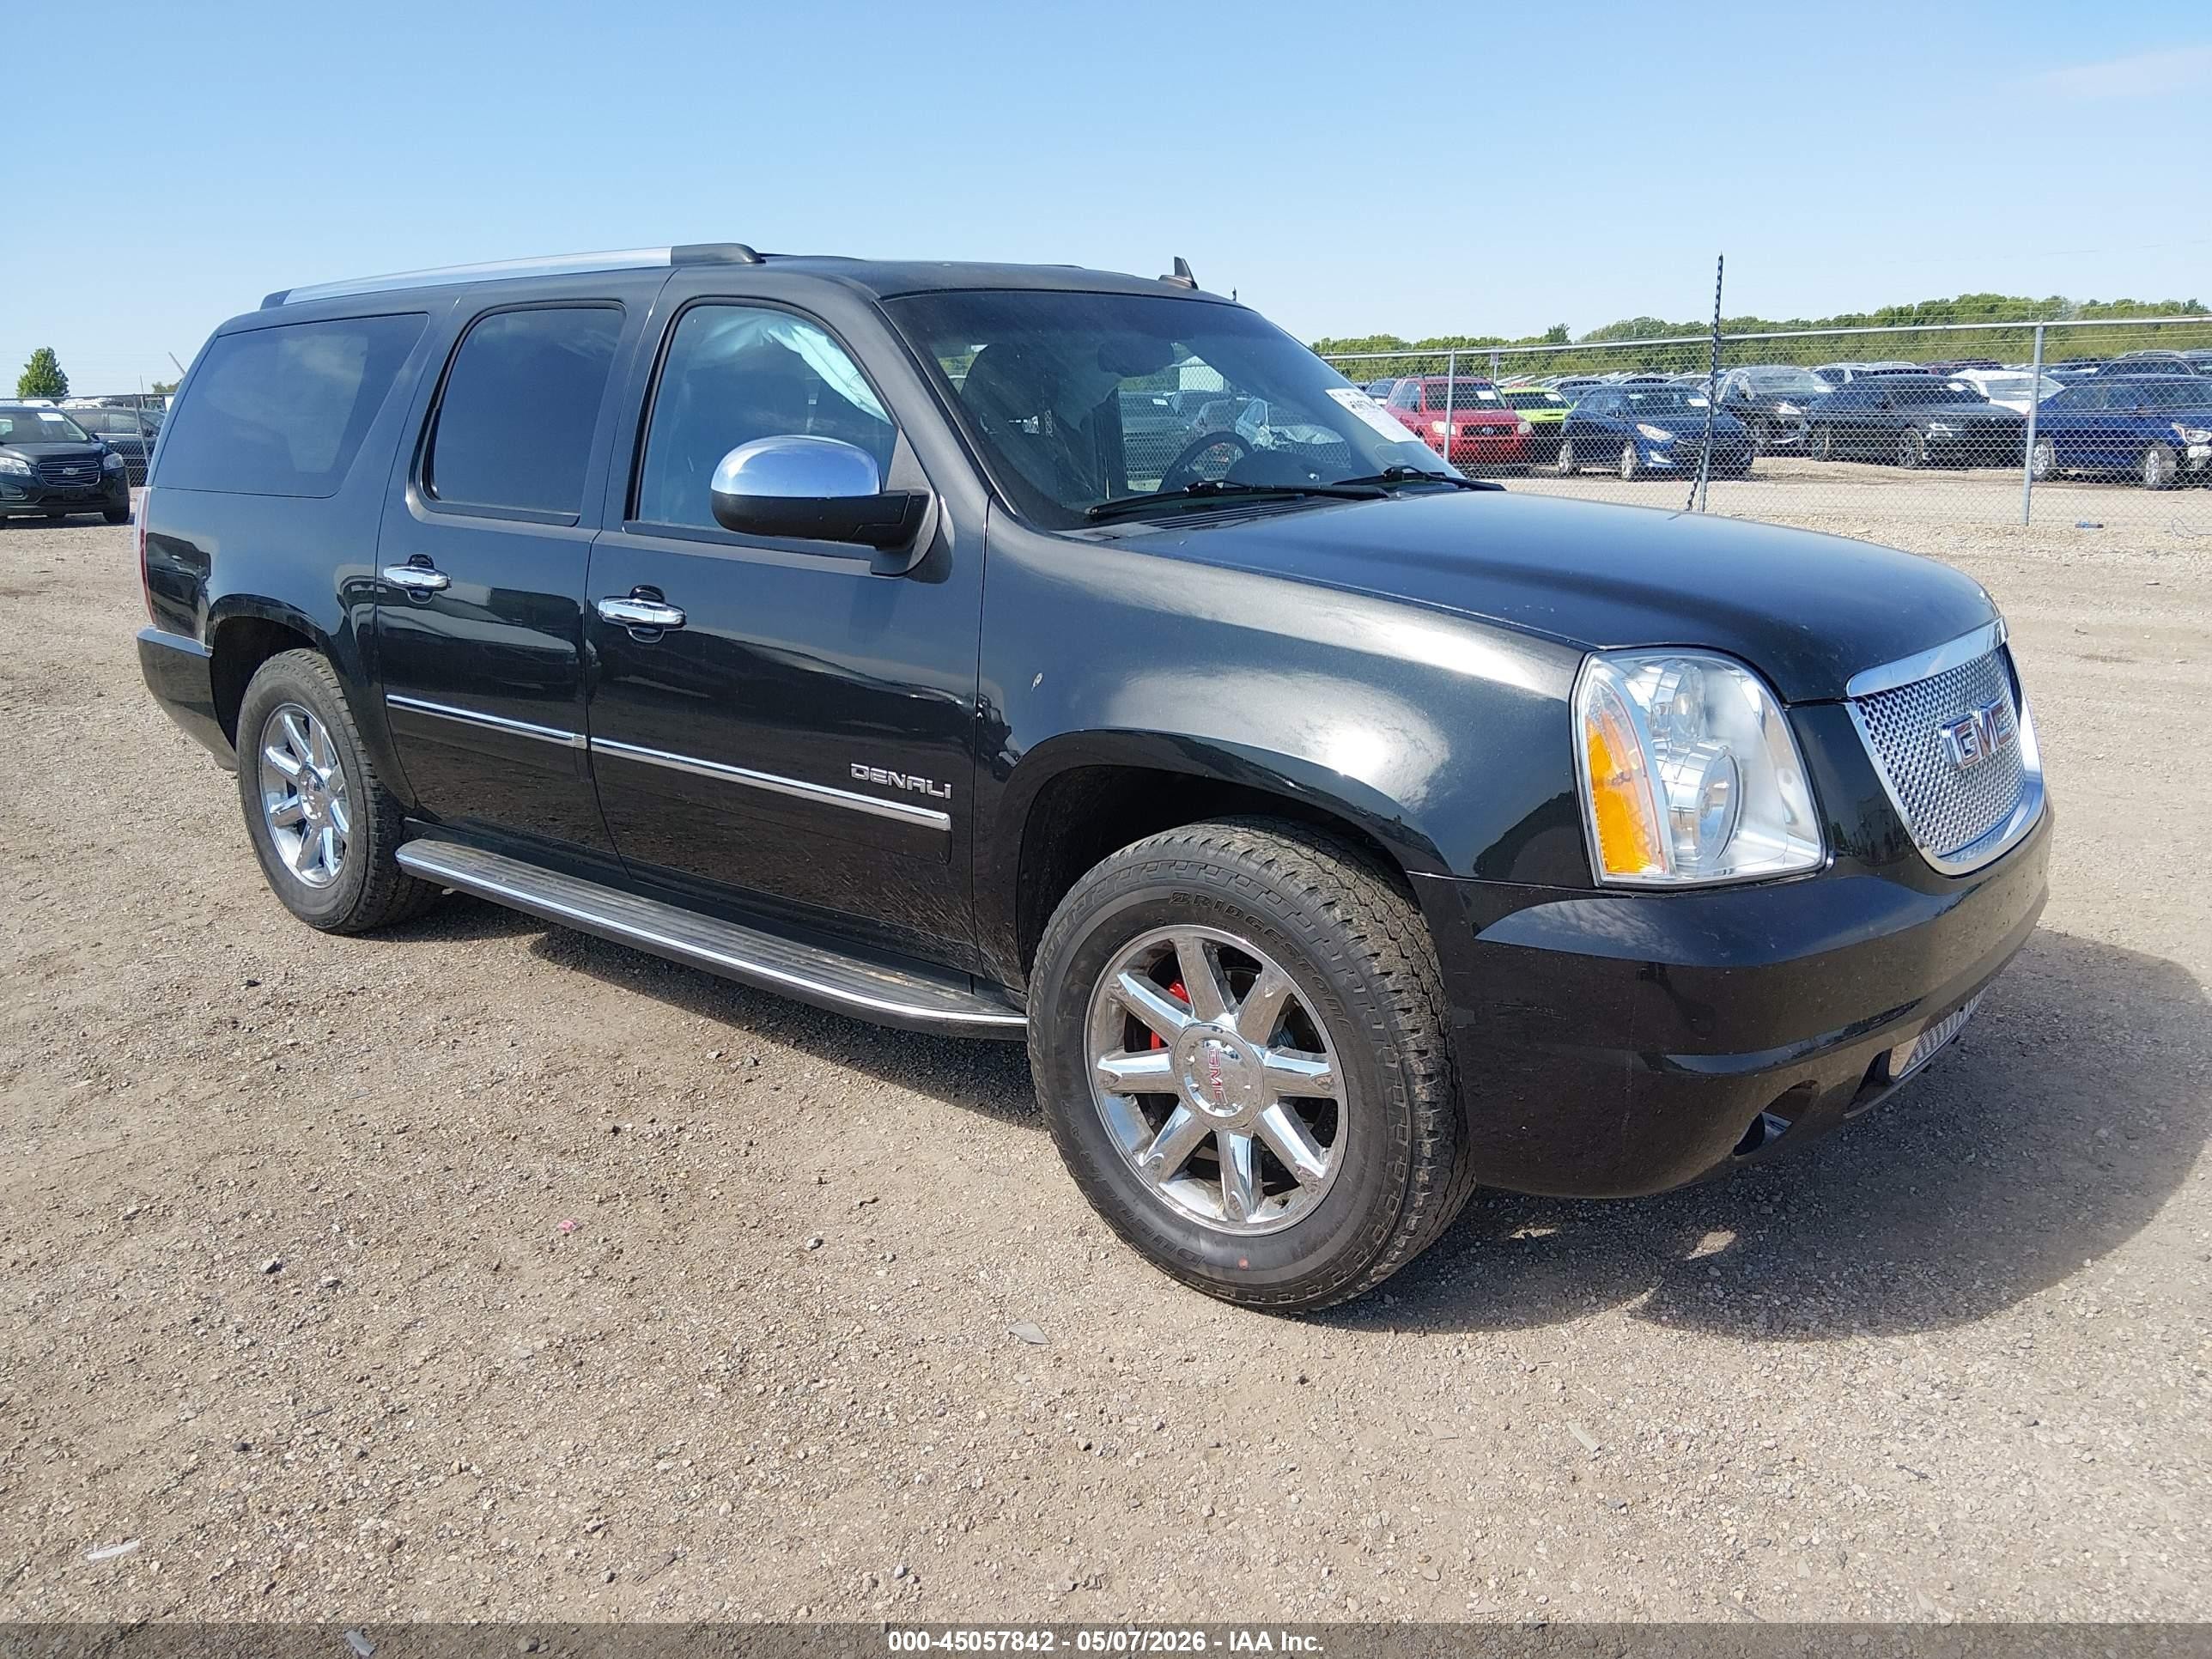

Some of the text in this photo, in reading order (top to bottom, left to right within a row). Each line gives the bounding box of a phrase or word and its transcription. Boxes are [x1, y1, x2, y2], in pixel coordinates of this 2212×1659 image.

[1942, 698, 2012, 769] GMC
[850, 763, 951, 799] DENALI
[1208, 1048, 1228, 1106] GMC
